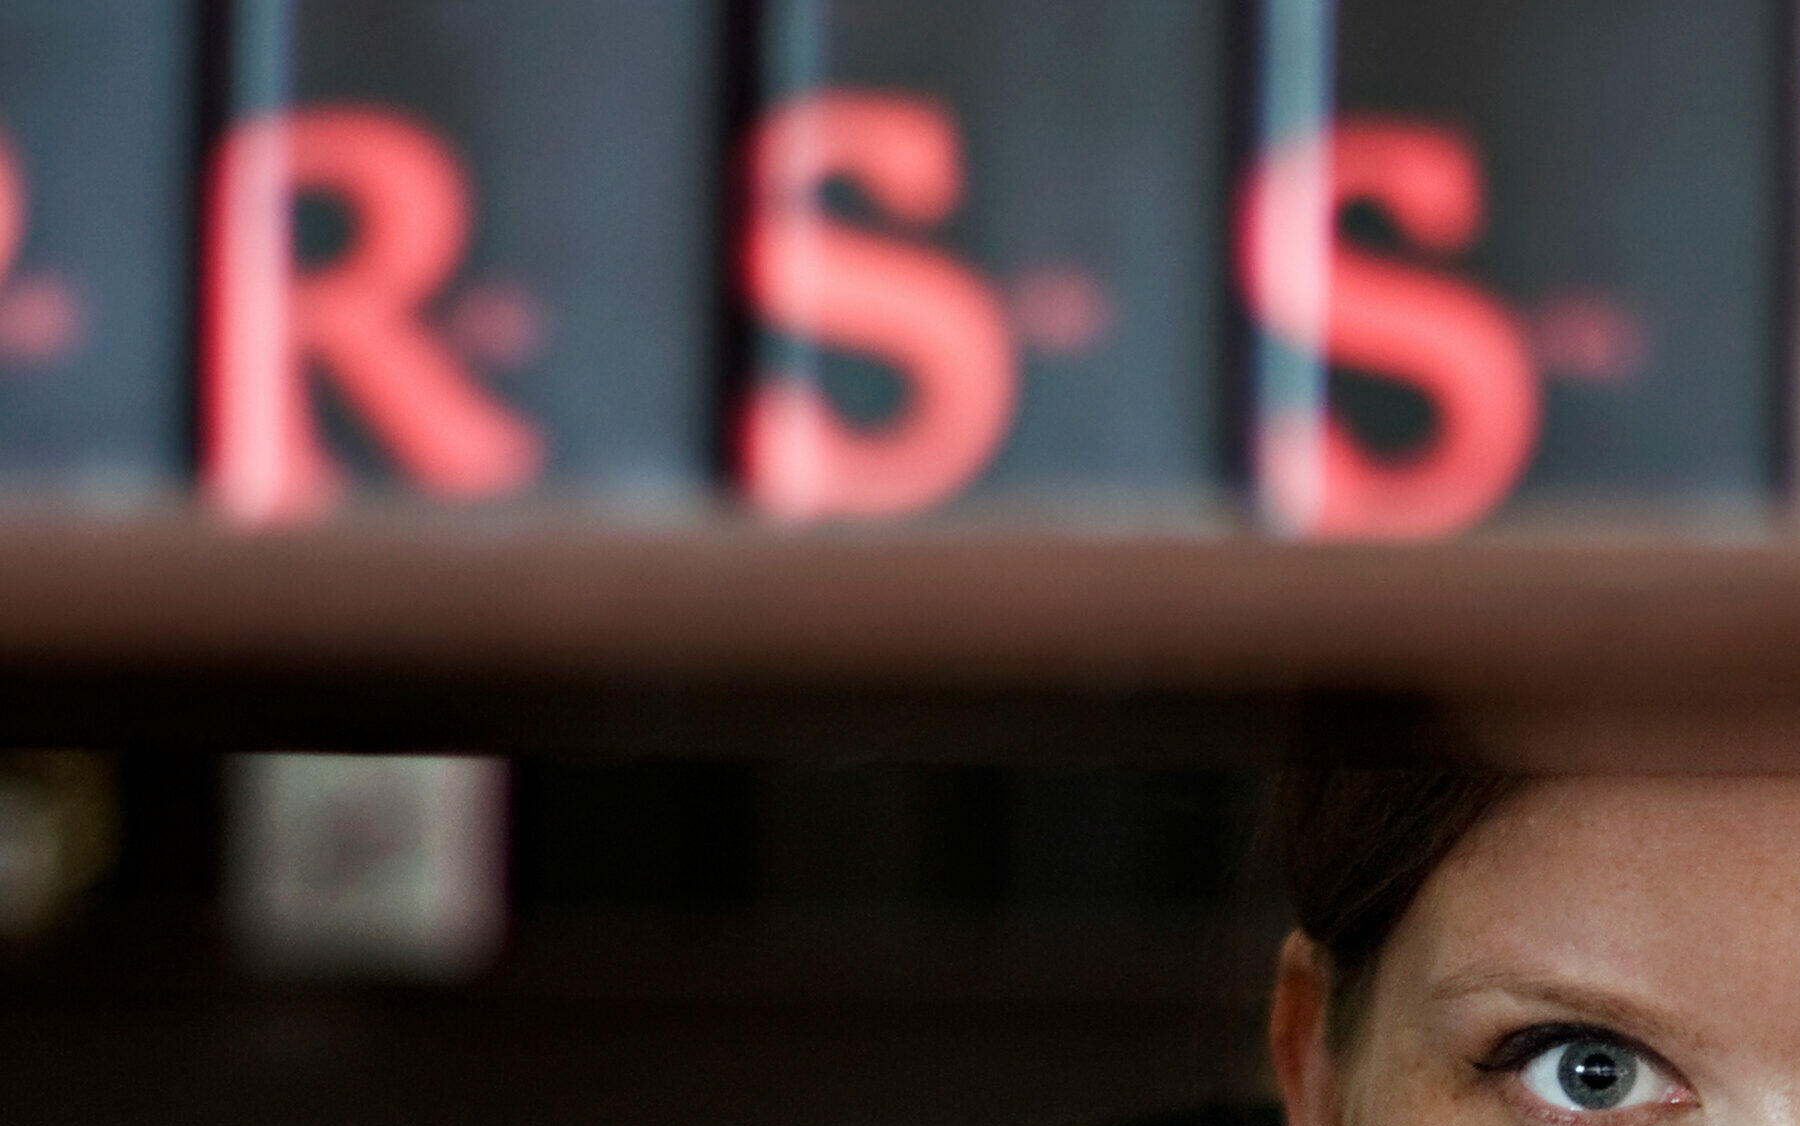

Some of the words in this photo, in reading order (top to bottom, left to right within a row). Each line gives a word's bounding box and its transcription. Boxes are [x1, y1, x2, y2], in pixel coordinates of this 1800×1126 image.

[203, 105, 542, 527] R
[738, 90, 1018, 524] S
[1237, 116, 1544, 546] S
